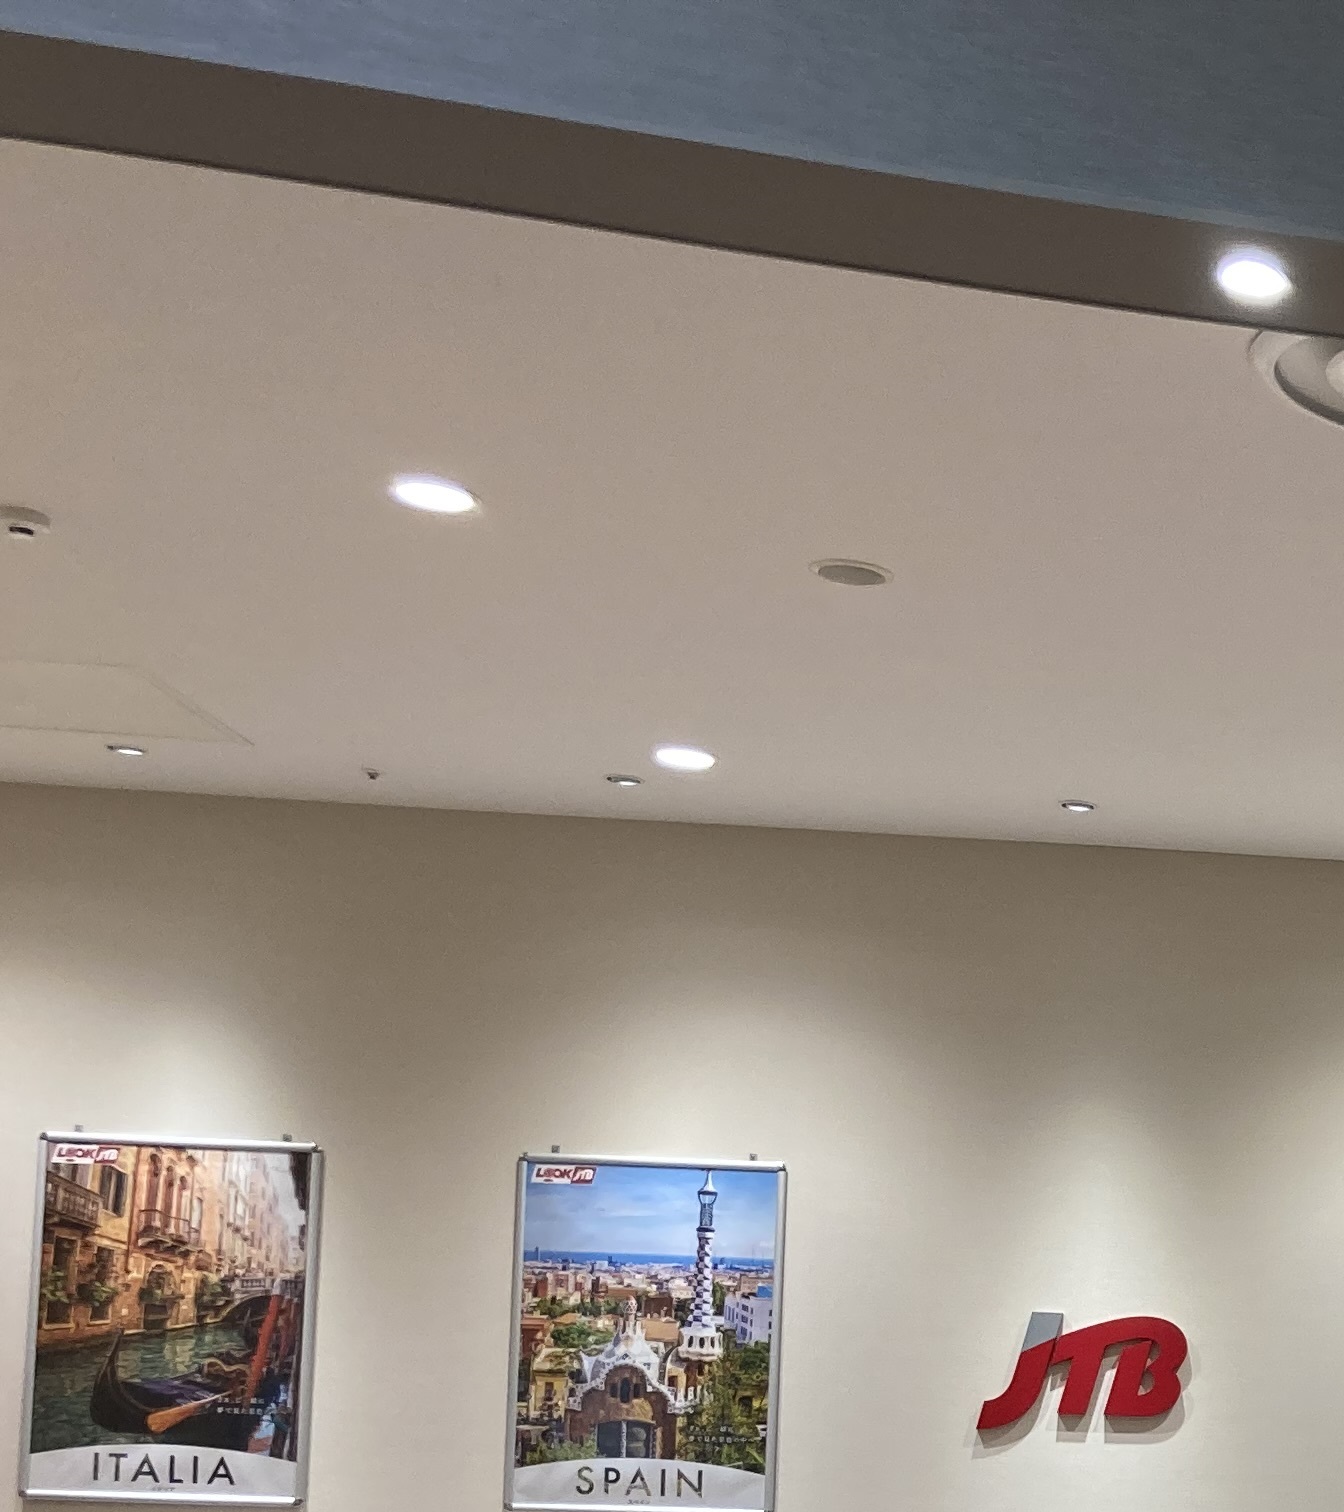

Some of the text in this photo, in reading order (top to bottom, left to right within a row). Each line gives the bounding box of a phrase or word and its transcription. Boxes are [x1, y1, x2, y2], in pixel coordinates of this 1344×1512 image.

[976, 1311, 1189, 1440] JTB
[92, 1452, 235, 1486] ITALIA
[575, 1466, 704, 1499] SPAIN
